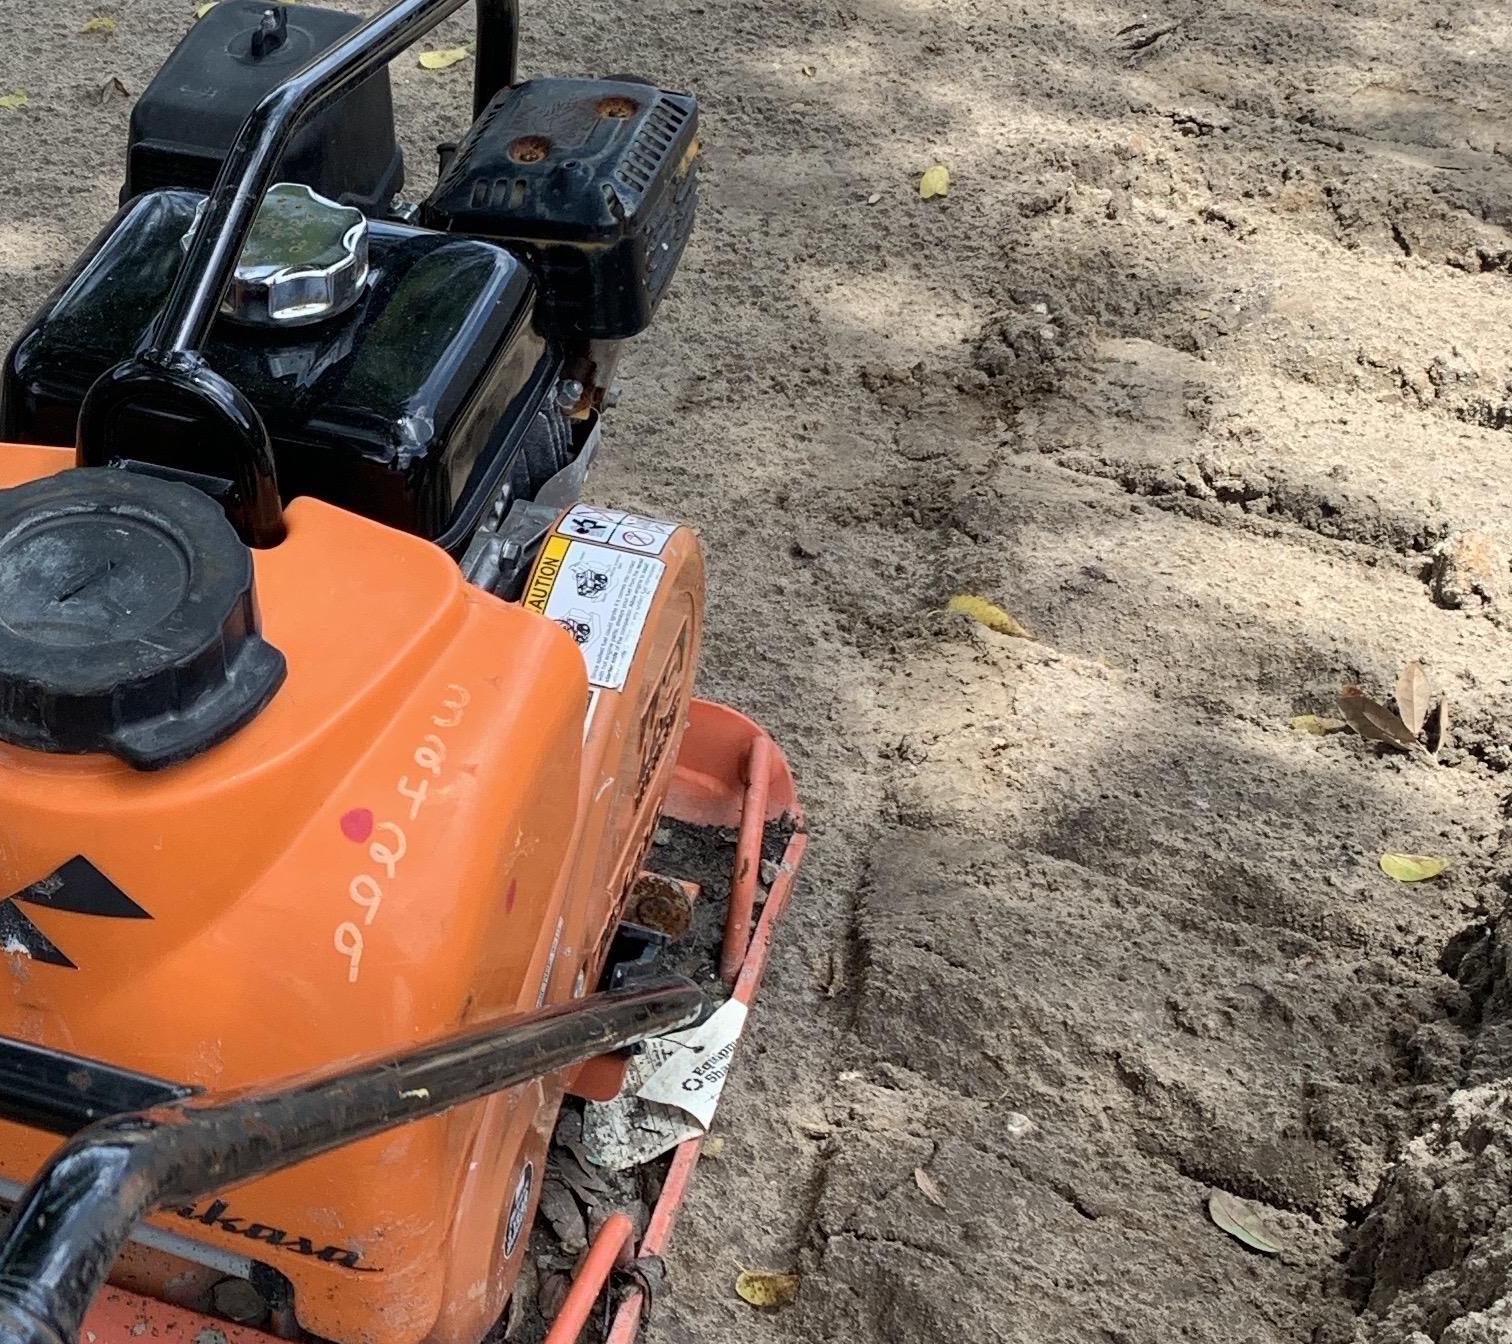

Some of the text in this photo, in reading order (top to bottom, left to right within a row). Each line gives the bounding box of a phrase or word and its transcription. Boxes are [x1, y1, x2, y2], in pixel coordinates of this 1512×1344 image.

[528, 557, 560, 613] AUTION
[334, 683, 471, 983] 324299
[177, 1199, 384, 1272] ikasa
